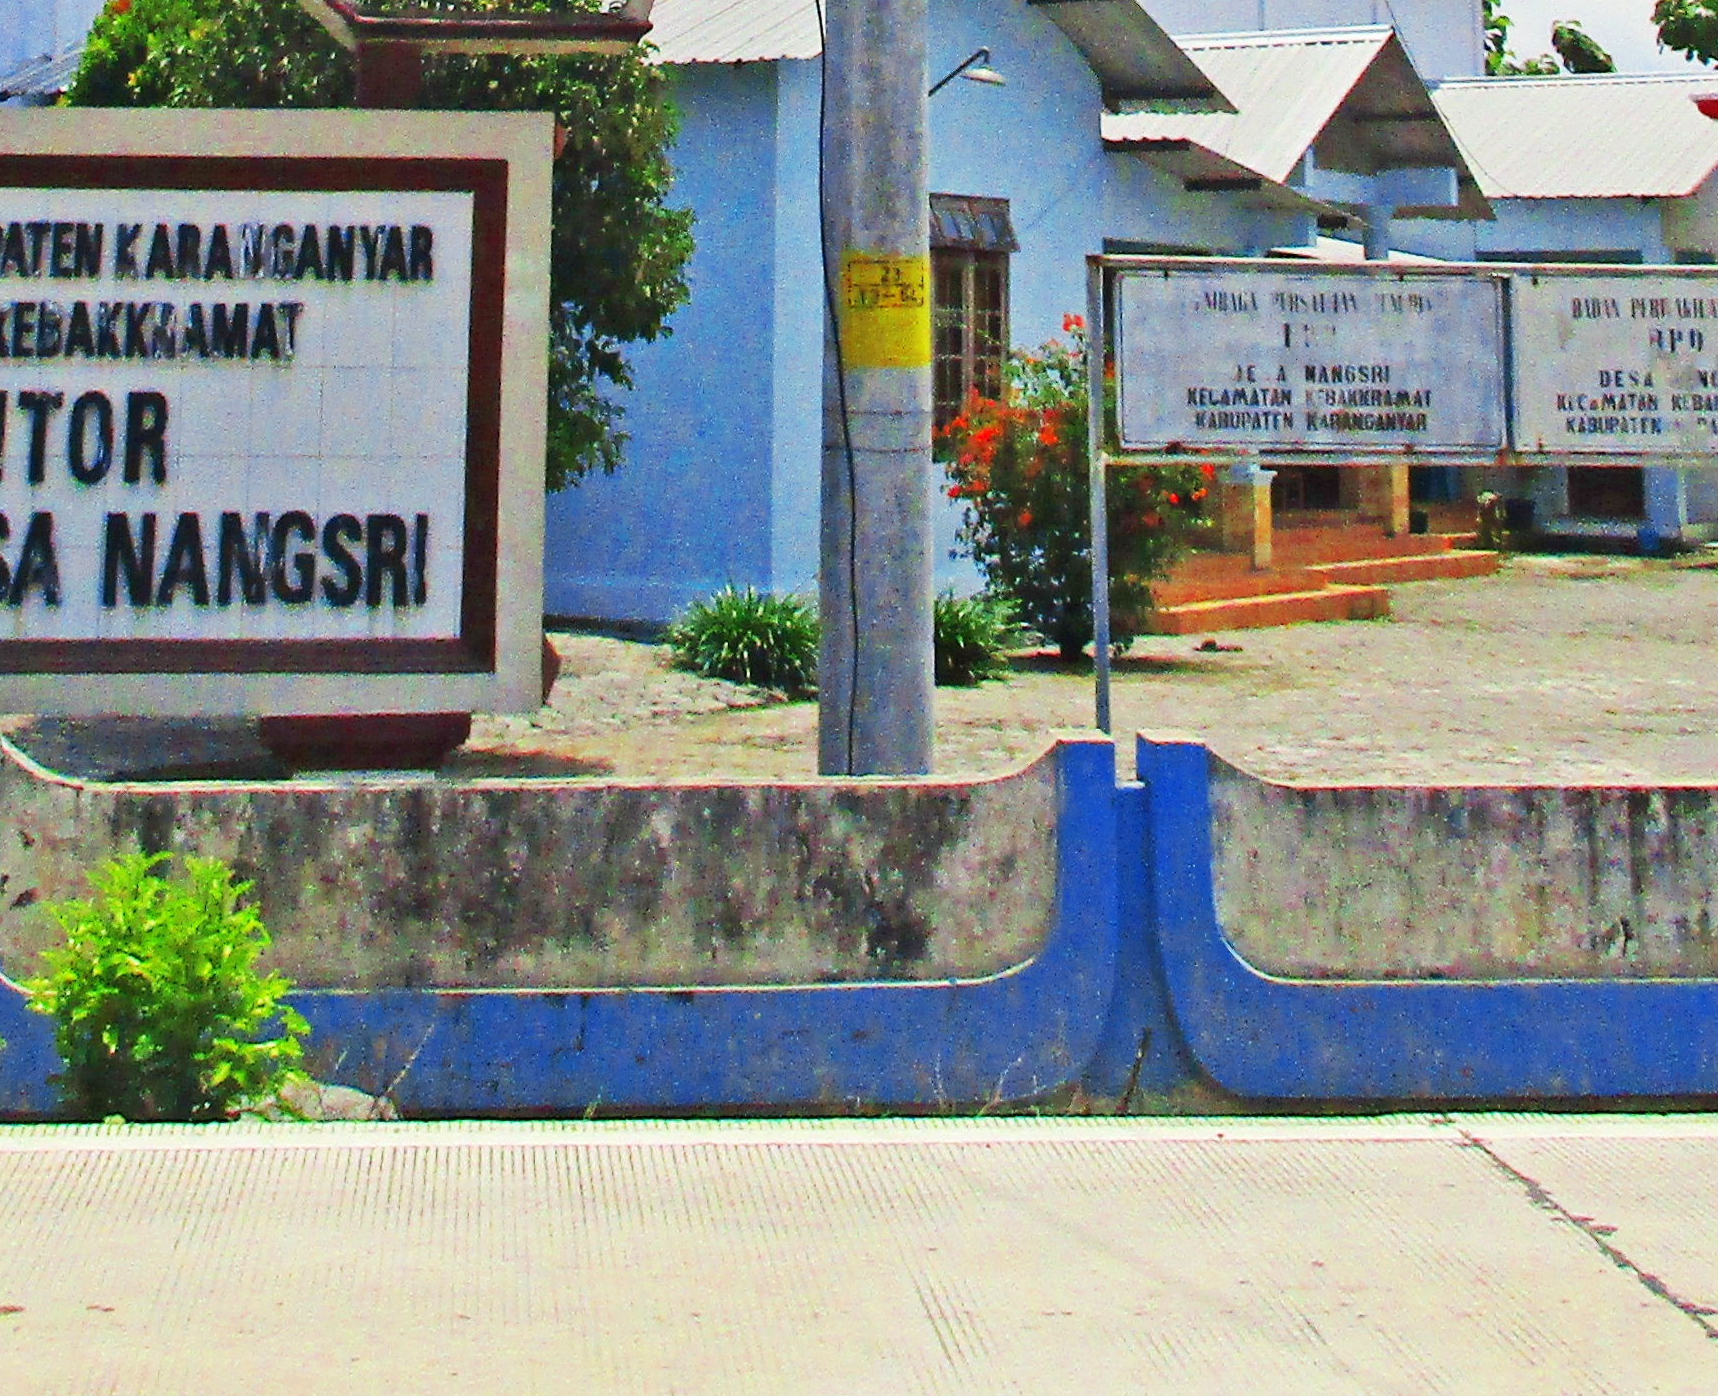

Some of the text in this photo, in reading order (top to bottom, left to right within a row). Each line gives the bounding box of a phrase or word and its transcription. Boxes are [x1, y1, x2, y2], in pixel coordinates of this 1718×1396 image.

[115, 222, 434, 283] KARANGANYAR
[1304, 365, 1390, 383] NANGSRI
[1600, 370, 1653, 387] DESA
[101, 511, 430, 610] NANGSRI
